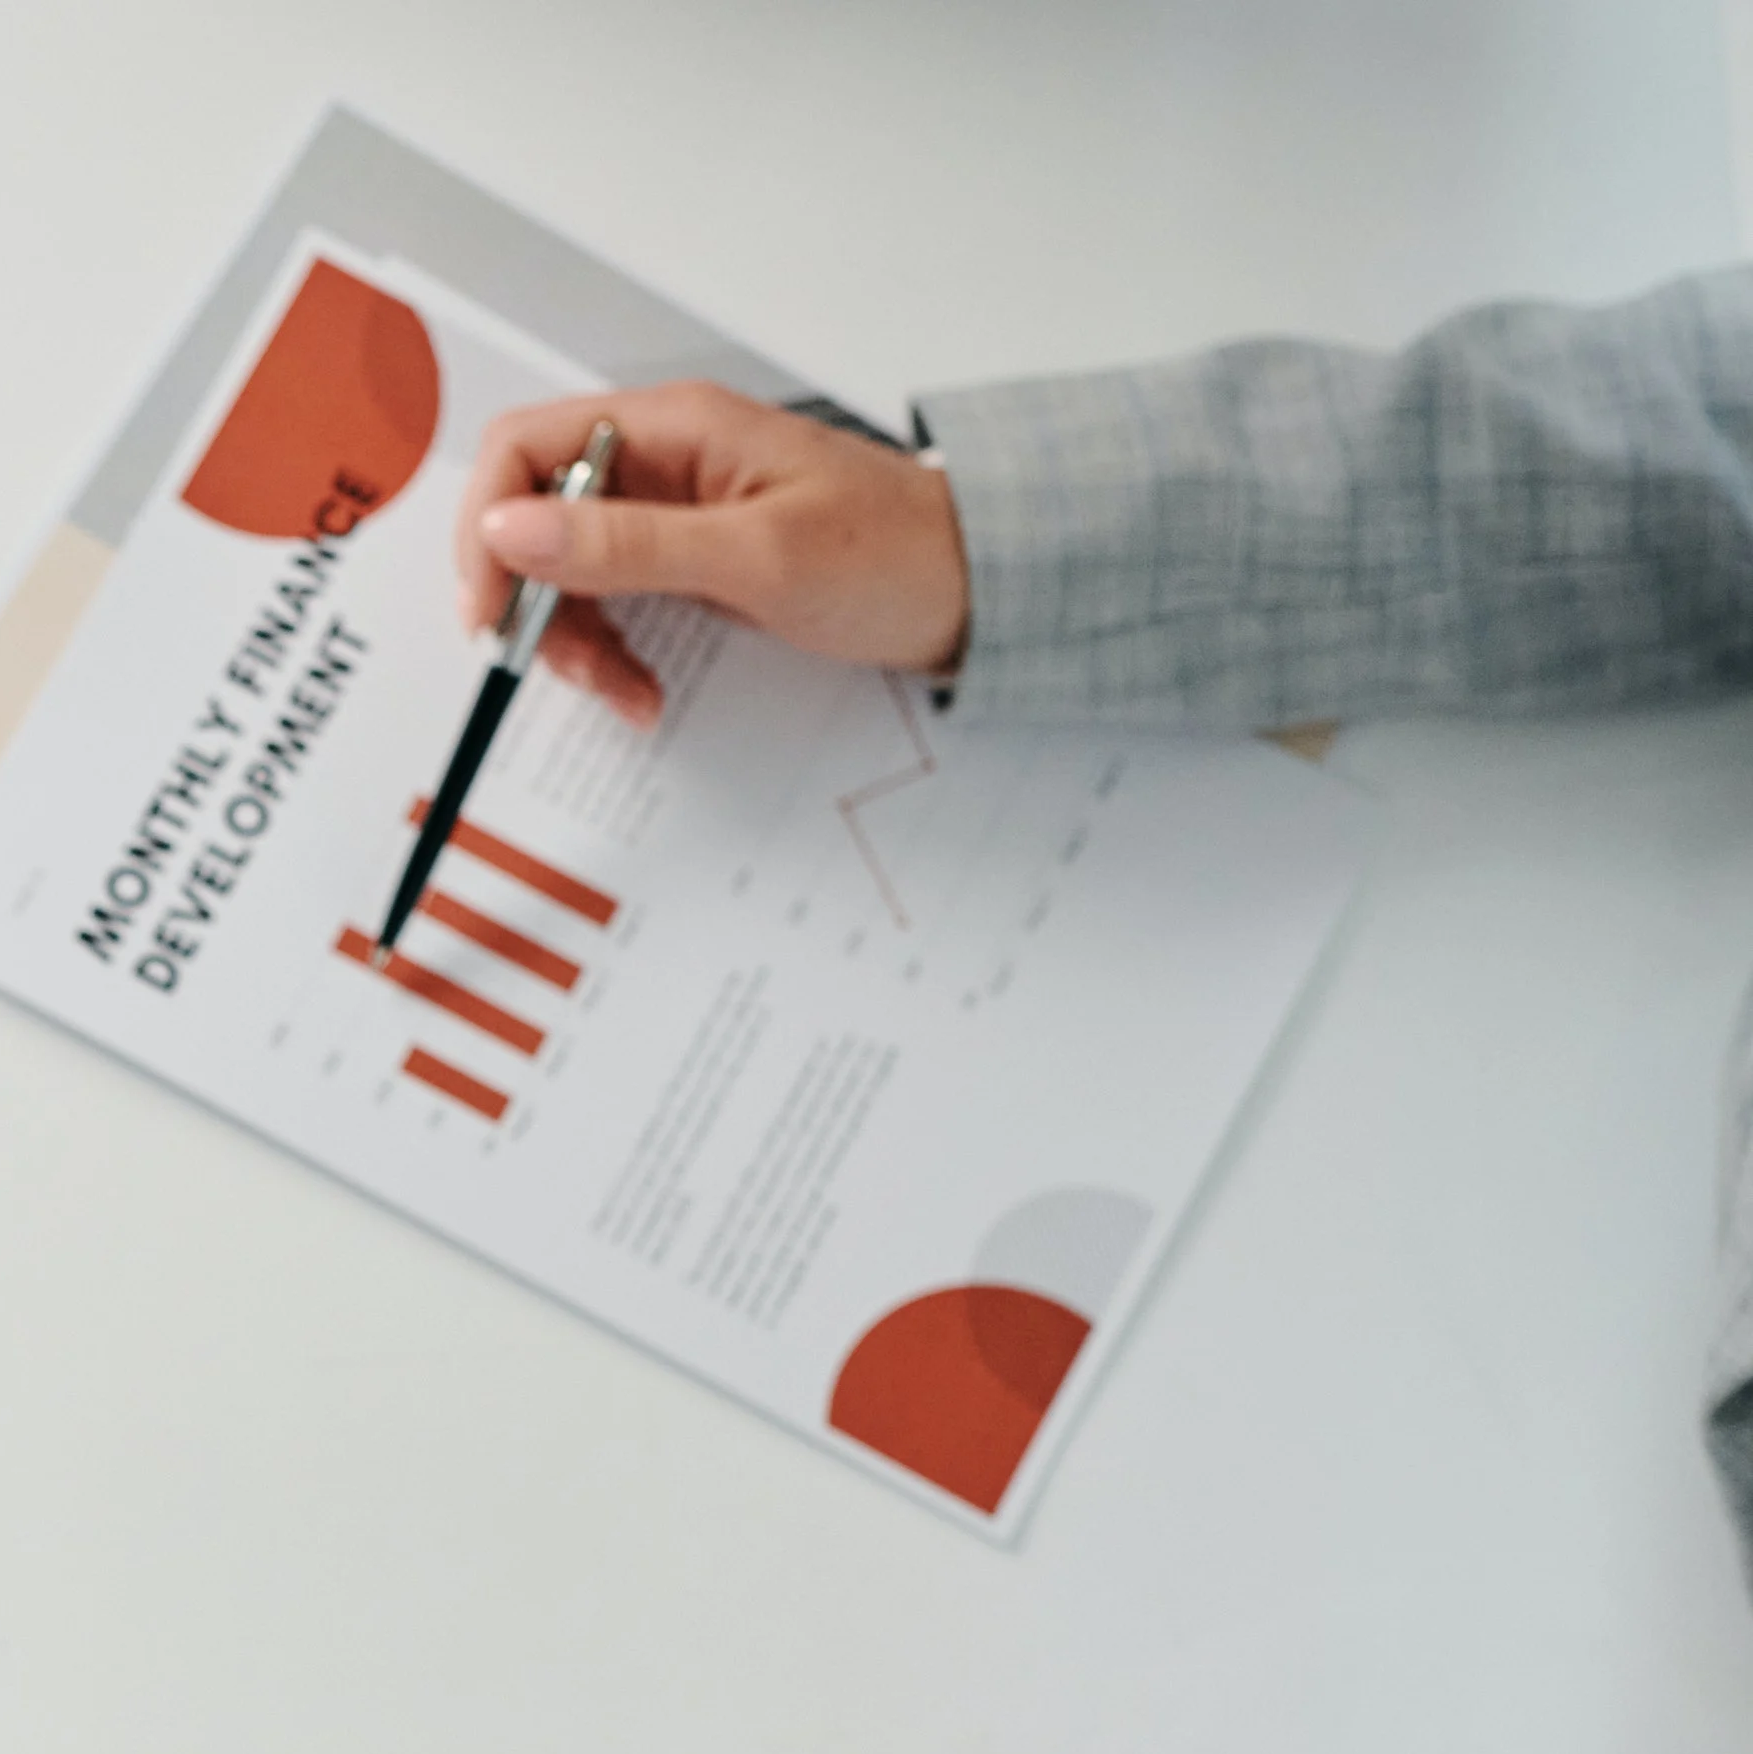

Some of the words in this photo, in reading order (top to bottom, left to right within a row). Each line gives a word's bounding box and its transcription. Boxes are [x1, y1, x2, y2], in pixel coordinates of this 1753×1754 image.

[77, 703, 238, 961] MONTHLY
[223, 466, 378, 701] FINANCE
[134, 621, 364, 993] DEVELOPMENT
